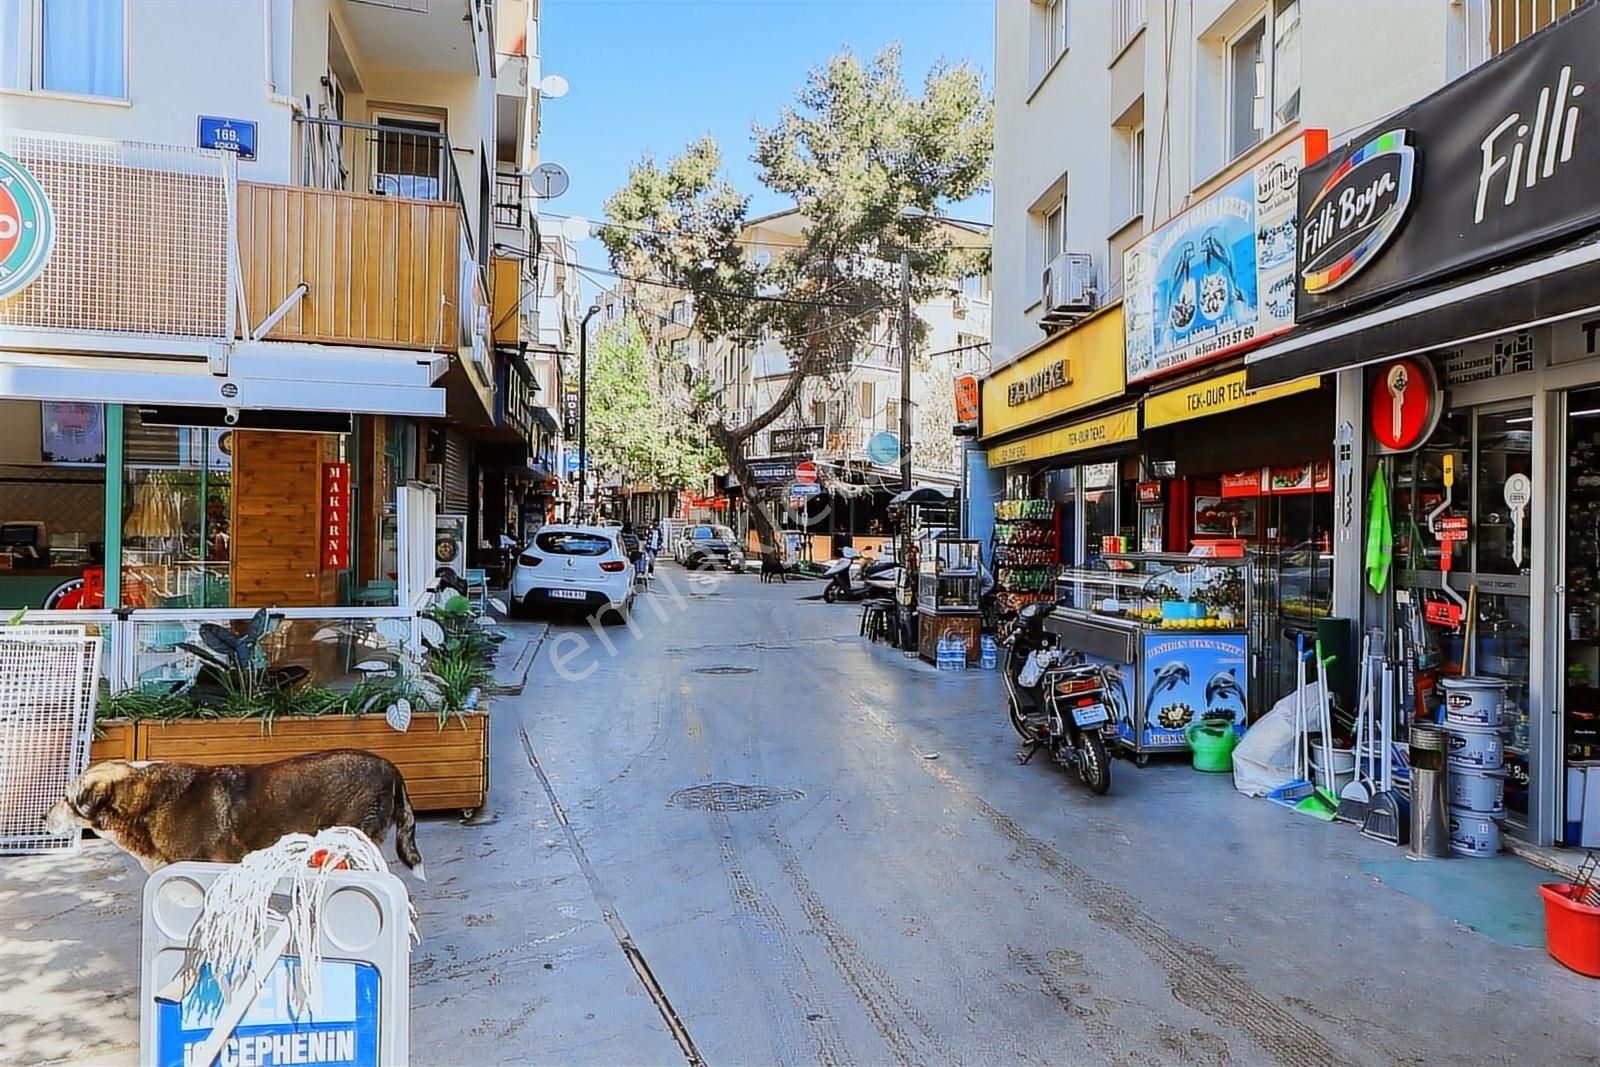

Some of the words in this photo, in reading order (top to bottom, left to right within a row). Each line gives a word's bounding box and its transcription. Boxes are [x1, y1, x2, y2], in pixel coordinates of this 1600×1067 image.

[214, 128, 240, 142] 169.
[1474, 65, 1585, 224] Filli
[1301, 202, 1336, 263] Filli
[1339, 172, 1396, 229] Boya
[566, 393, 578, 435] motel
[1228, 381, 1257, 401] TEK
[328, 467, 341, 565] MAKARNA
